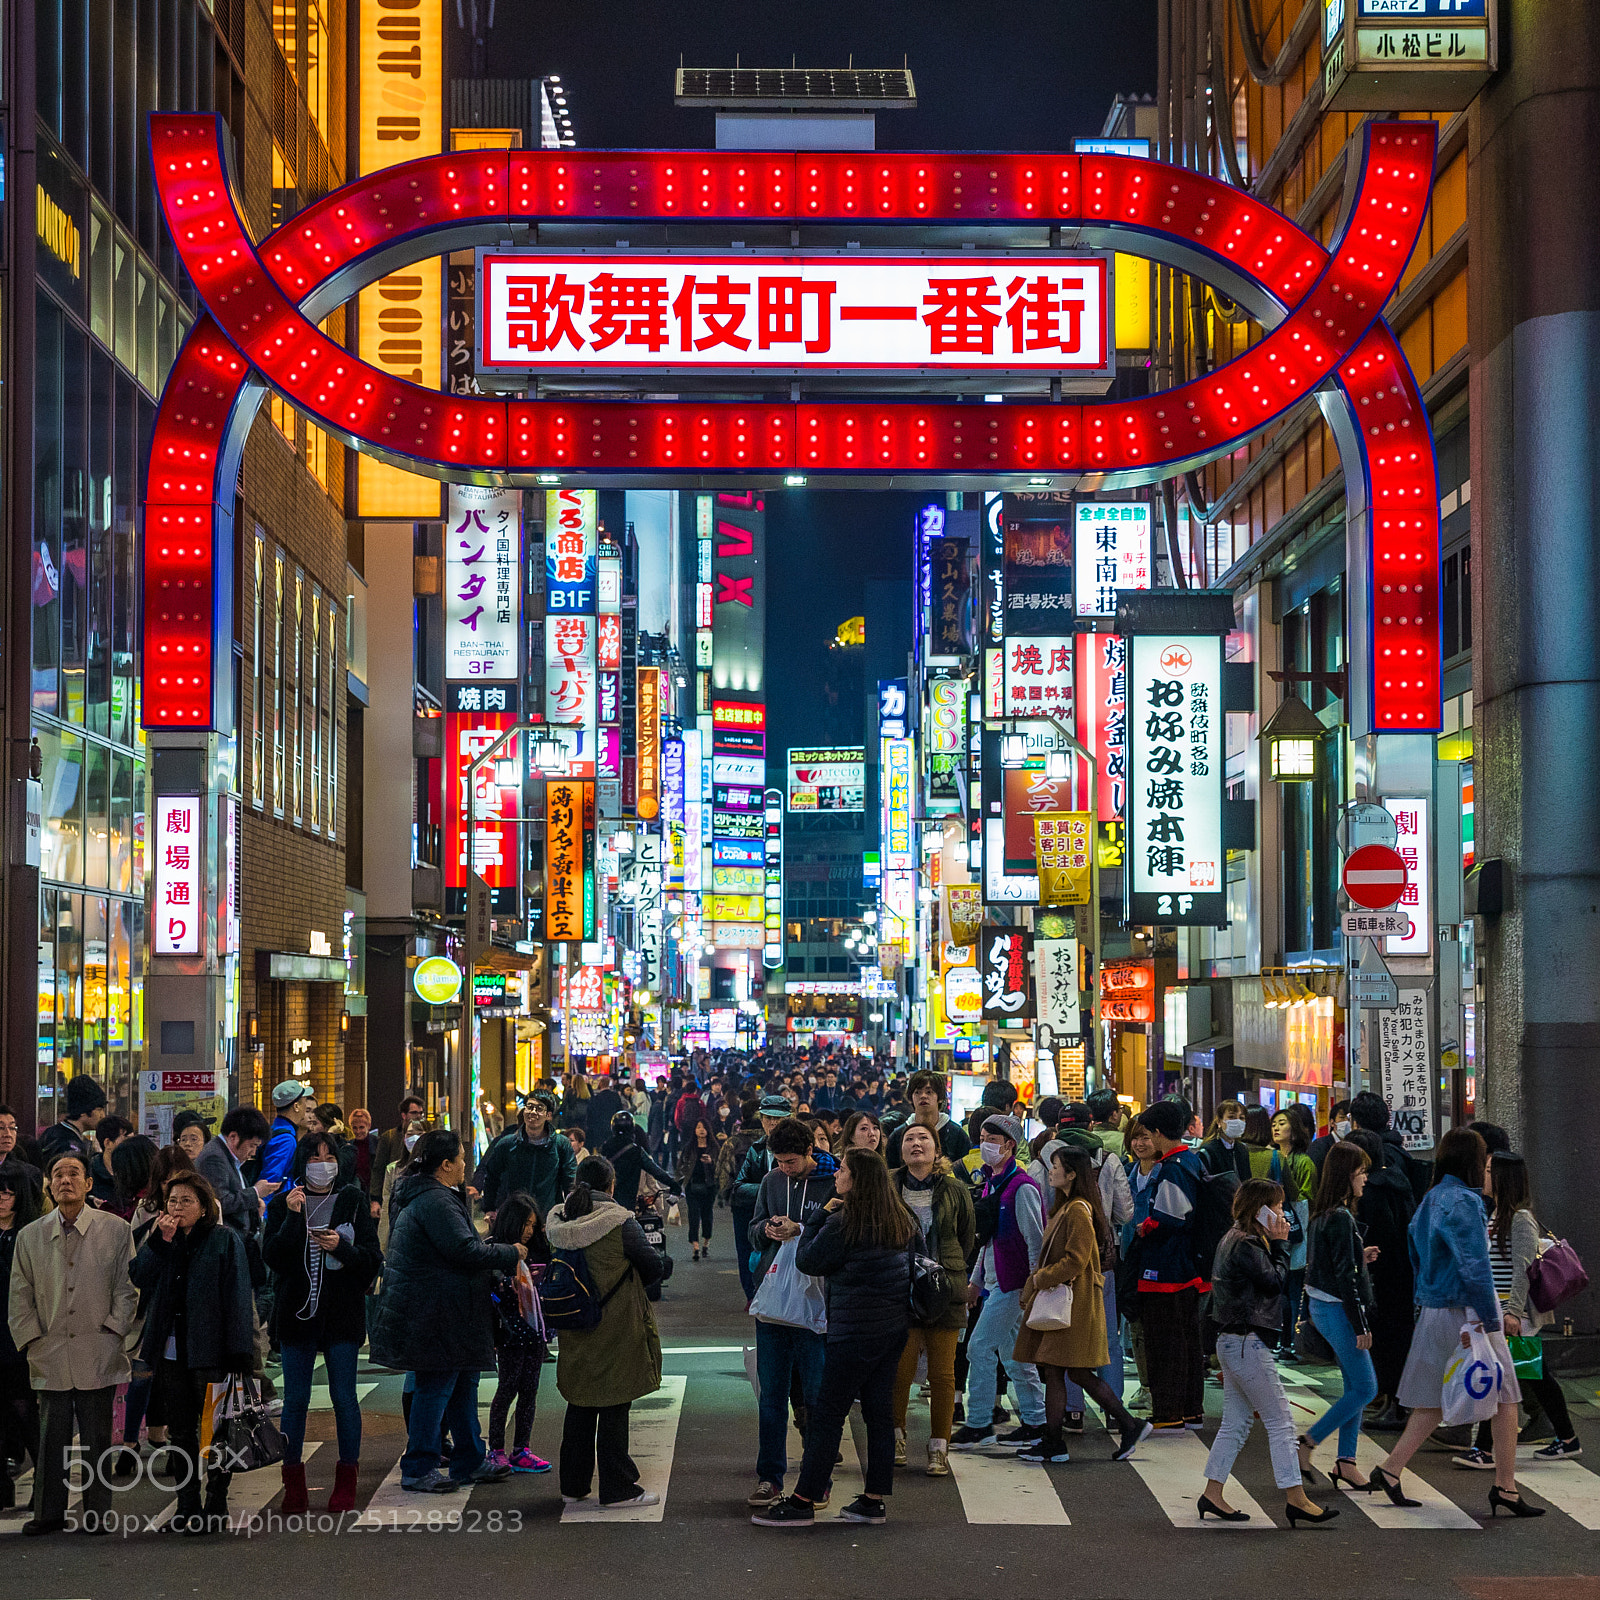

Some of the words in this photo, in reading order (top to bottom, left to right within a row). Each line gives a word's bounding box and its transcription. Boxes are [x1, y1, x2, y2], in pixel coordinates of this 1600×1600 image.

[1377, 33, 1465, 57] 小松ビル
[506, 273, 1085, 354] 歌舞伎町一番街
[1079, 507, 1146, 521] 全卓全自動
[455, 509, 490, 631] バンタイ
[496, 510, 510, 623] タイ国料理専門店
[1095, 526, 1117, 613] 東南荘
[550, 590, 590, 608] B1F
[1079, 604, 1091, 613] 3F
[468, 661, 494, 674] 3F
[458, 688, 506, 710] 焼肉
[602, 673, 616, 721] レンタル
[1012, 686, 1072, 700] 韓国料理
[715, 707, 762, 724] 全店営業中
[1190, 683, 1209, 776] 歌舞伎町名物
[1146, 679, 1186, 877] お好み焼本陣
[1040, 821, 1086, 835] 悪質な
[1041, 837, 1085, 852] 客引き
[1041, 854, 1087, 868] に注意
[166, 809, 190, 941] 劇場通り
[1158, 894, 1193, 915] 2F
[1347, 916, 1404, 931] 自転車を除く
[1050, 947, 1077, 1024] お好み焼き
[1382, 1017, 1391, 1049] Security
[1391, 1019, 1399, 1035] Your
[1059, 1038, 1080, 1047] B1F
[1392, 1039, 1400, 1064] Safety
[1384, 1051, 1392, 1081] Camera
